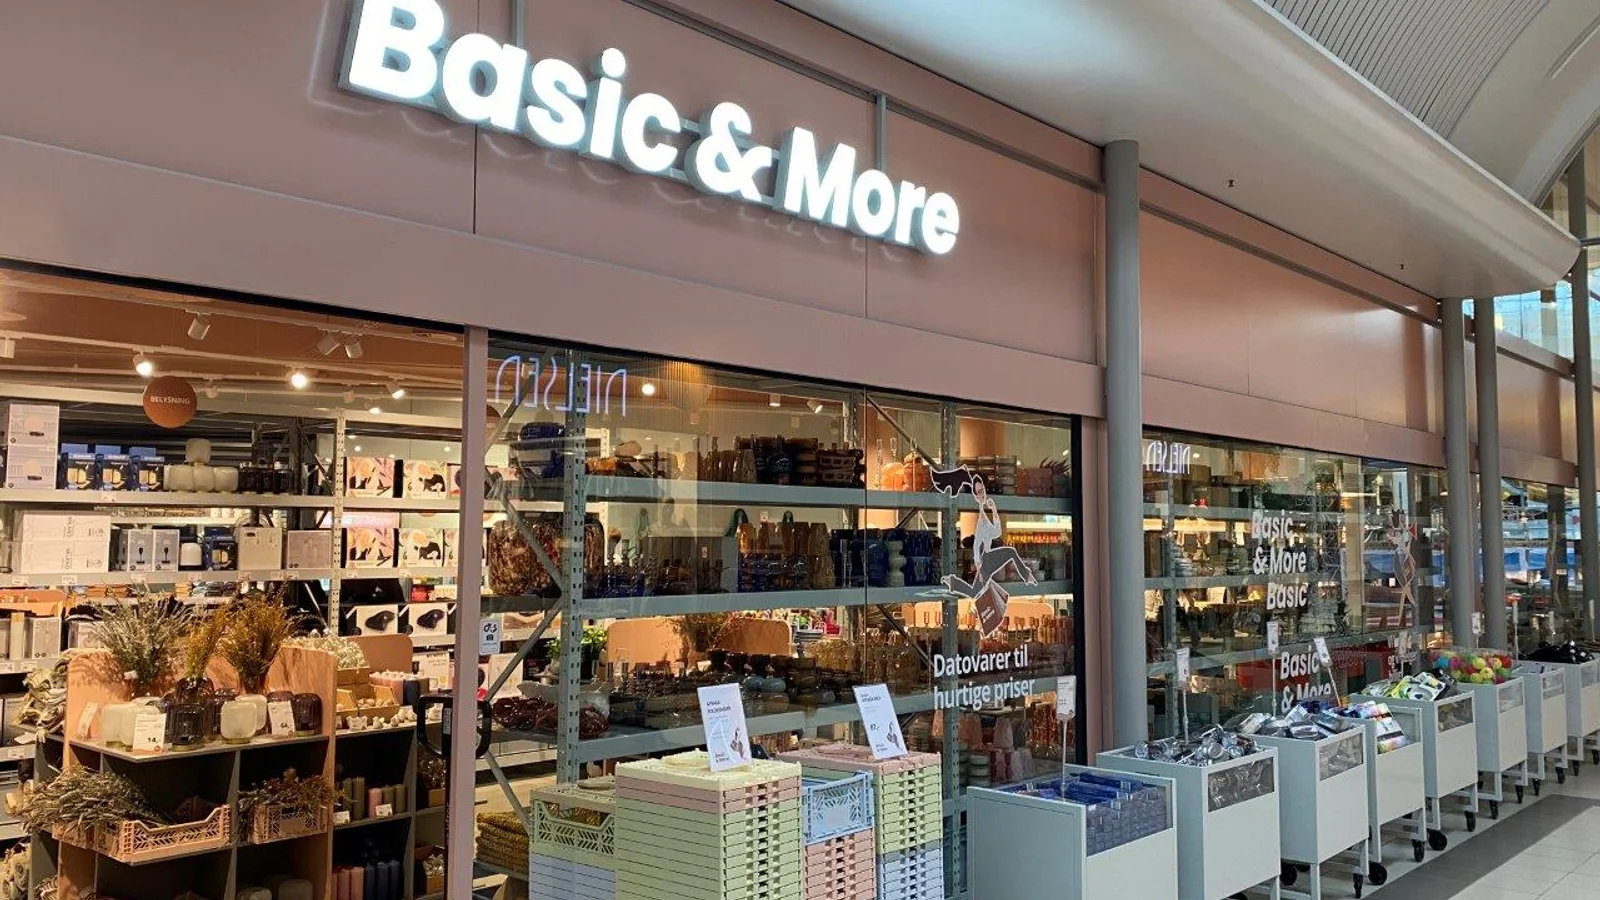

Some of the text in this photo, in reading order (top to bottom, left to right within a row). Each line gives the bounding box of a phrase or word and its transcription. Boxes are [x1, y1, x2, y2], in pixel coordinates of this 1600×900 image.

[345, 0, 960, 255] Basic & More
[149, 395, 190, 405] BELYSNING
[1252, 509, 1293, 539] Basic
[1253, 546, 1307, 575] & More
[1267, 578, 1308, 610] Basic
[933, 643, 1029, 678] Datovarer til
[1280, 644, 1320, 680] Basic
[933, 676, 1036, 711] hurtige priser
